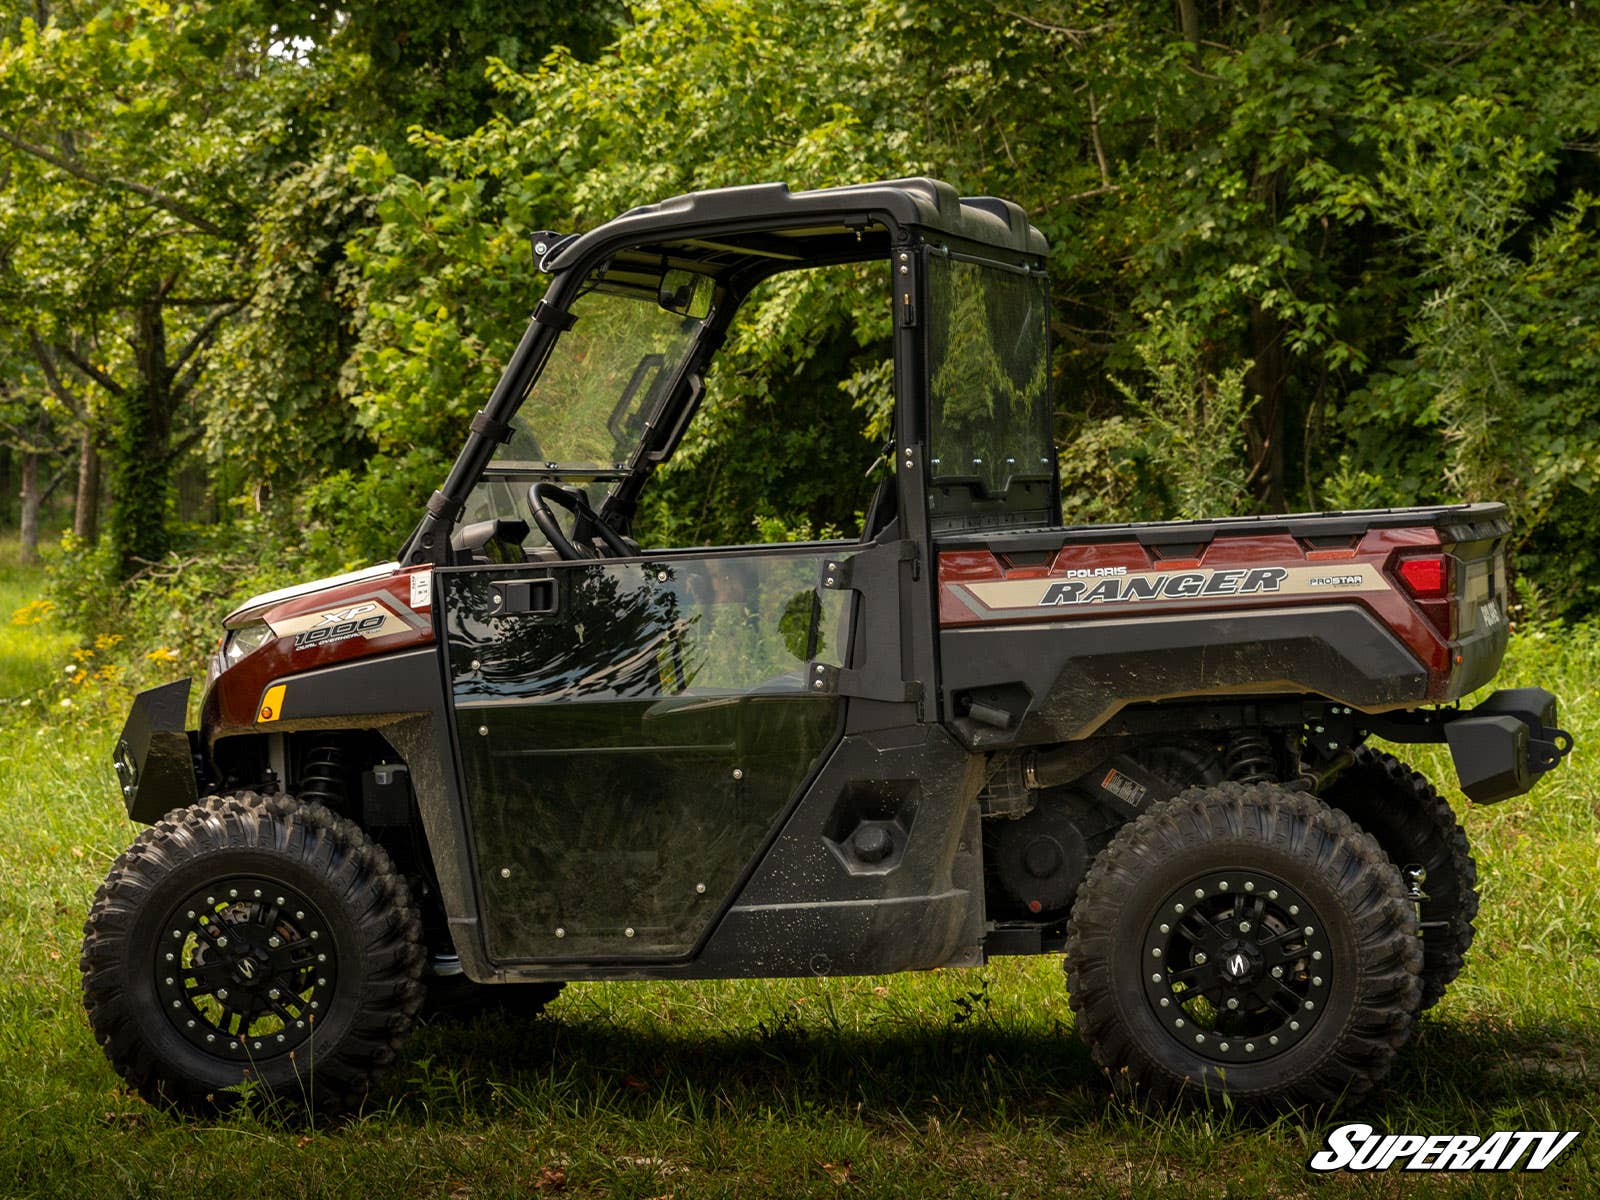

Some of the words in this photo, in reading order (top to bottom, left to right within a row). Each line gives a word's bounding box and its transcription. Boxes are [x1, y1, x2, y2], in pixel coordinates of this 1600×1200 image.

[1067, 566, 1127, 578] POLARIS
[1308, 575, 1363, 586] PROSTAR
[1039, 566, 1288, 607] RANGER
[311, 603, 377, 628] XP
[294, 614, 386, 646] 1000
